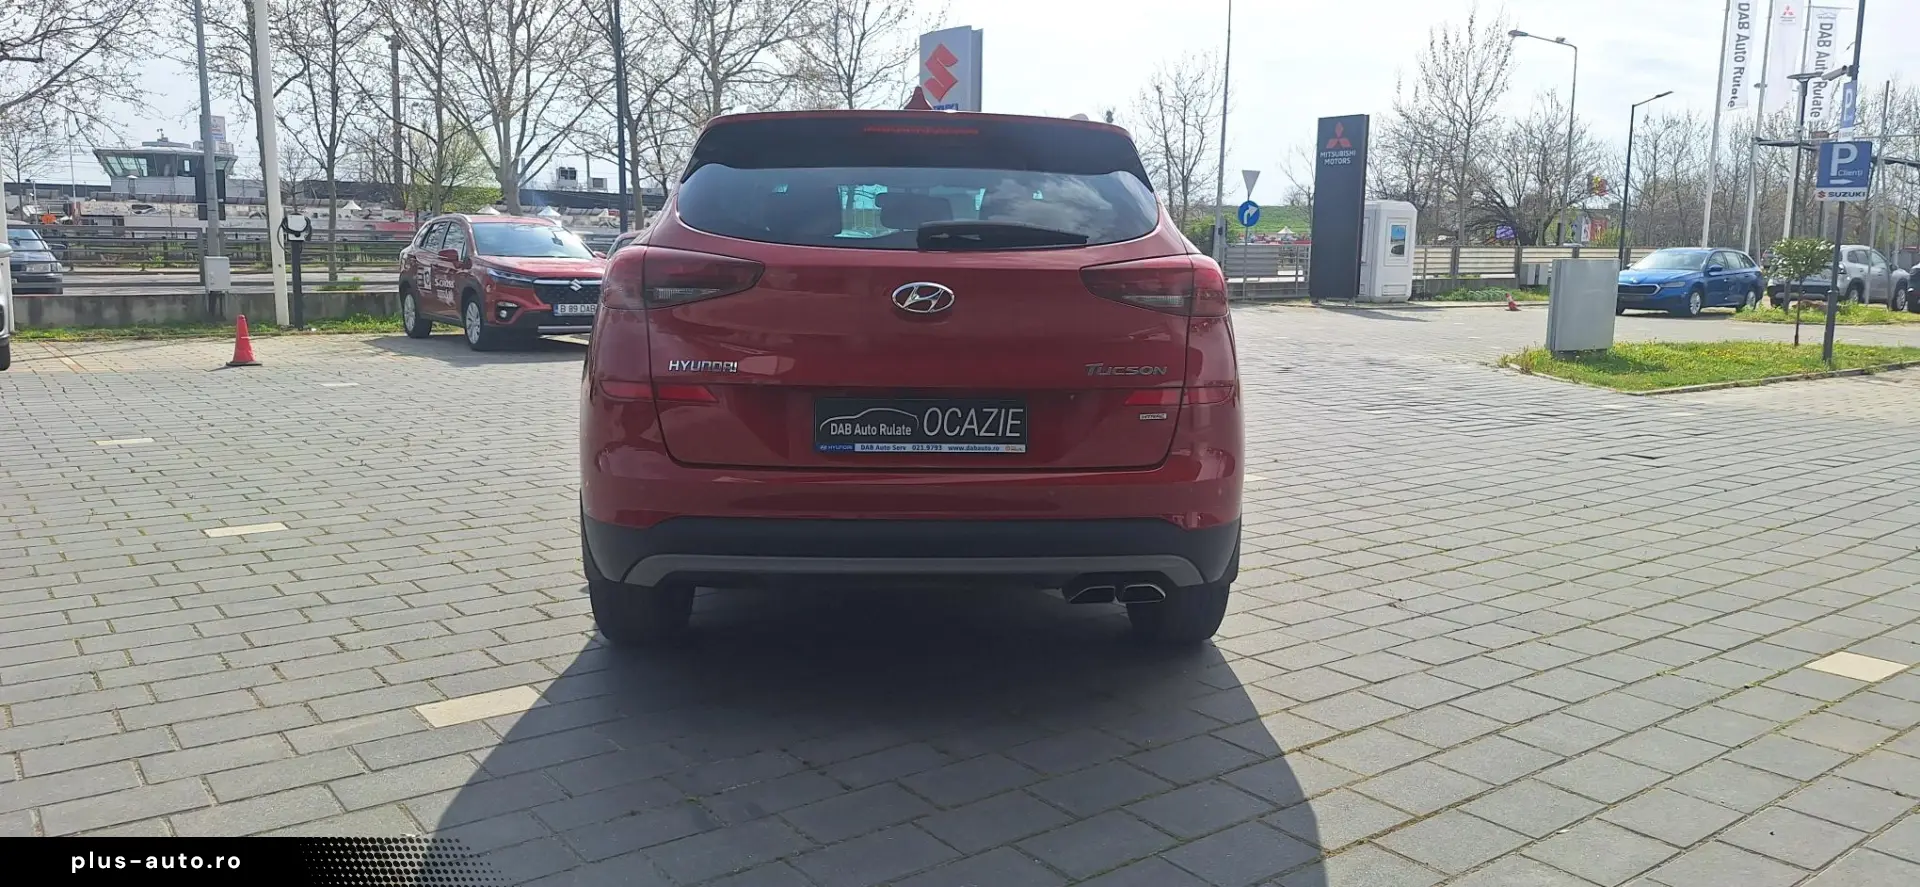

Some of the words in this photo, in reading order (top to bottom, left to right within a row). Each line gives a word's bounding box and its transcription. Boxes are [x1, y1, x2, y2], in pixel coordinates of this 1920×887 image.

[1737, 2, 1750, 30] DAB
[1733, 33, 1750, 63] Auto
[1817, 22, 1833, 48] DAB
[1815, 50, 1831, 74] Aut
[1727, 66, 1745, 108] Rulate
[1809, 80, 1828, 118] Rulate
[1319, 150, 1357, 158] MITSUBISHI
[1324, 157, 1352, 165] MOTORS
[1830, 143, 1858, 176] P
[560, 304, 566, 313] B
[580, 304, 596, 313] DAB
[668, 360, 738, 373] HYUNDAI
[830, 423, 852, 435] DAB
[854, 424, 877, 435] Auto
[880, 424, 912, 436] Rulate
[923, 407, 1024, 437] OCAZIE
